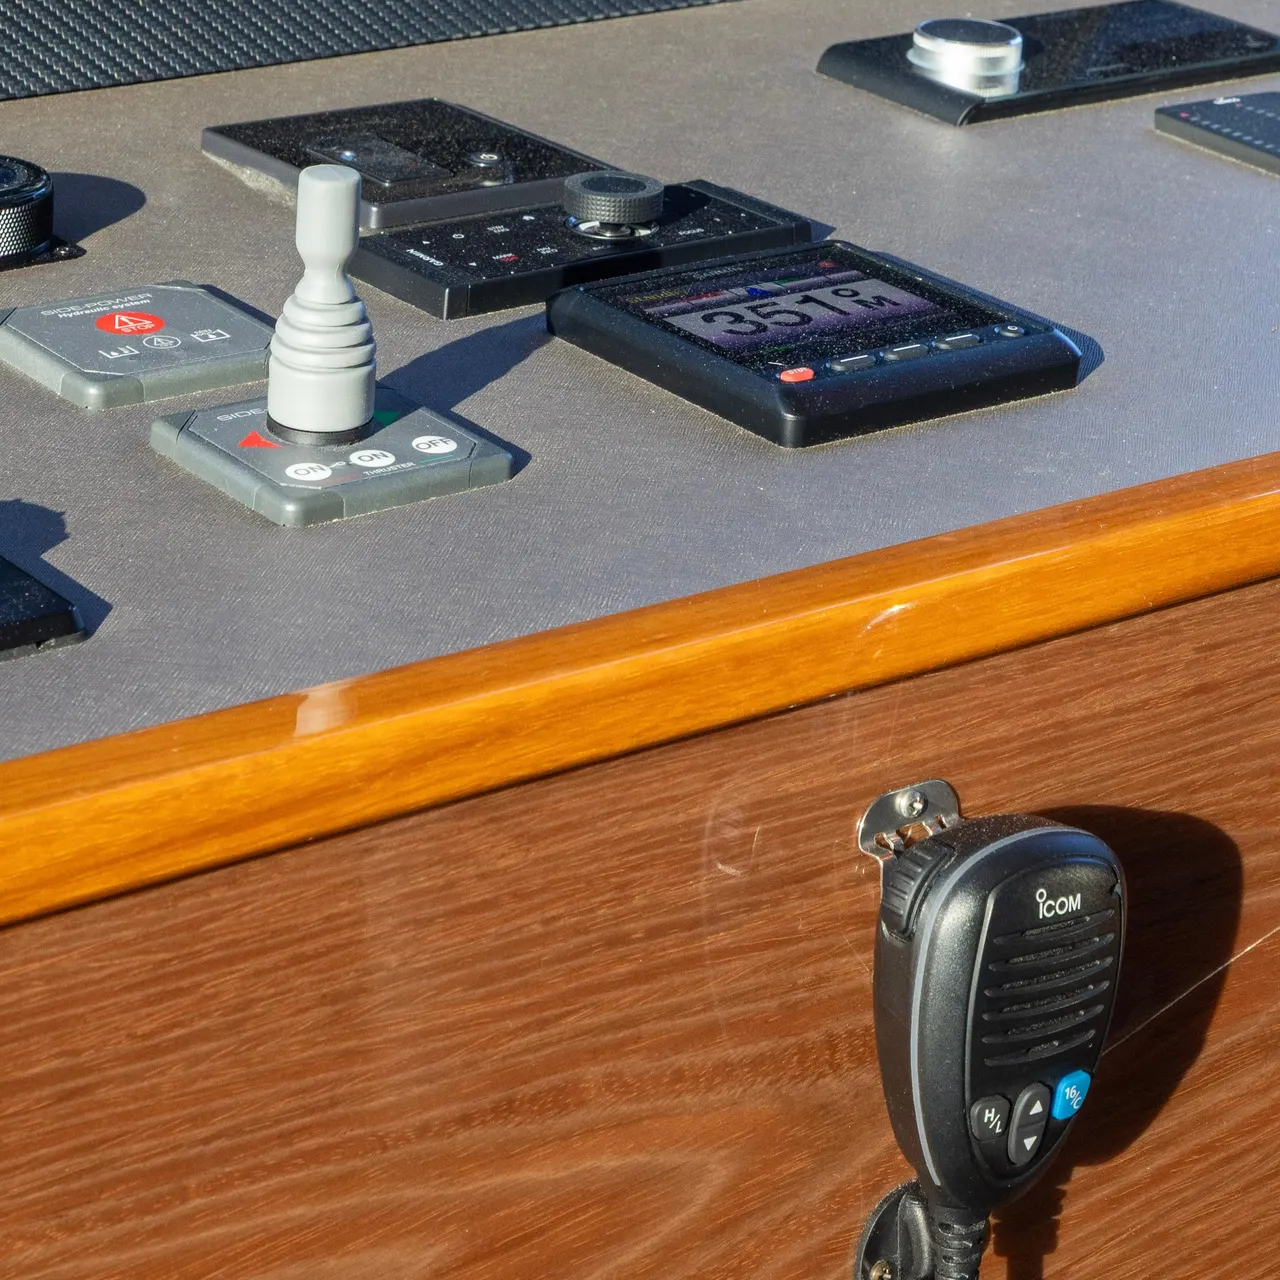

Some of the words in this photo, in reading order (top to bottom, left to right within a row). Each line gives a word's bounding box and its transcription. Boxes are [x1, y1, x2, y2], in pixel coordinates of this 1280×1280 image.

[40, 292, 154, 316] SIDE-POWER
[57, 305, 110, 319] Hydraulic
[111, 299, 151, 310] system
[120, 322, 155, 333] STOP
[414, 436, 454, 452] OFF
[358, 452, 389, 464] ON
[294, 463, 327, 477] ON
[363, 462, 416, 477] THRUSTER
[1064, 1085, 1082, 1110] 16/C
[984, 1108, 1003, 1135] H/L
